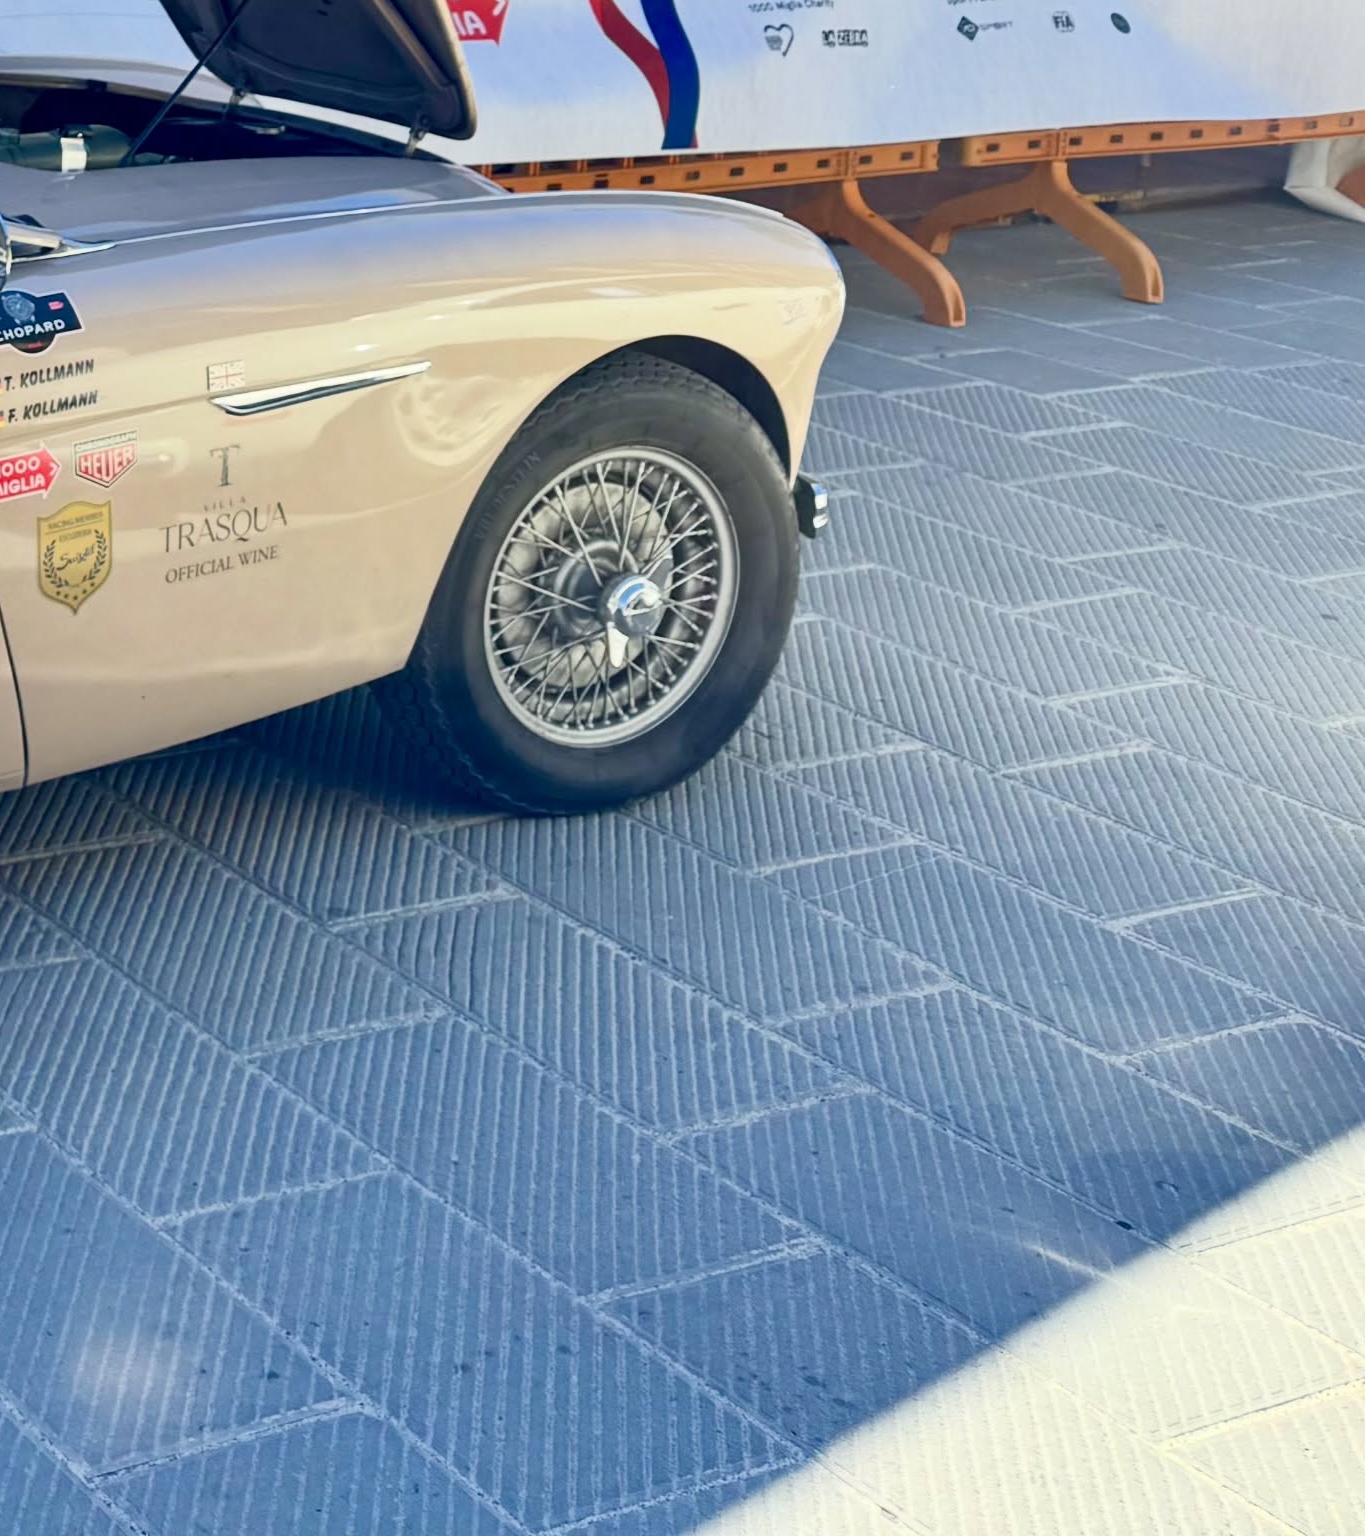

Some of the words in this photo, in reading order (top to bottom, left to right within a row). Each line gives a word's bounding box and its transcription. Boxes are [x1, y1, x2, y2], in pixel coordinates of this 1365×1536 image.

[4, 375, 16, 392] T.
[20, 359, 94, 389] KOLLMANN
[8, 408, 19, 424] F.
[23, 390, 98, 421] KOLLMANN
[80, 446, 134, 482] HEUER
[204, 495, 246, 512] VILLA
[159, 501, 287, 553] TRASQUA
[165, 556, 235, 584] OFFICIAL
[238, 545, 279, 566] WINE
